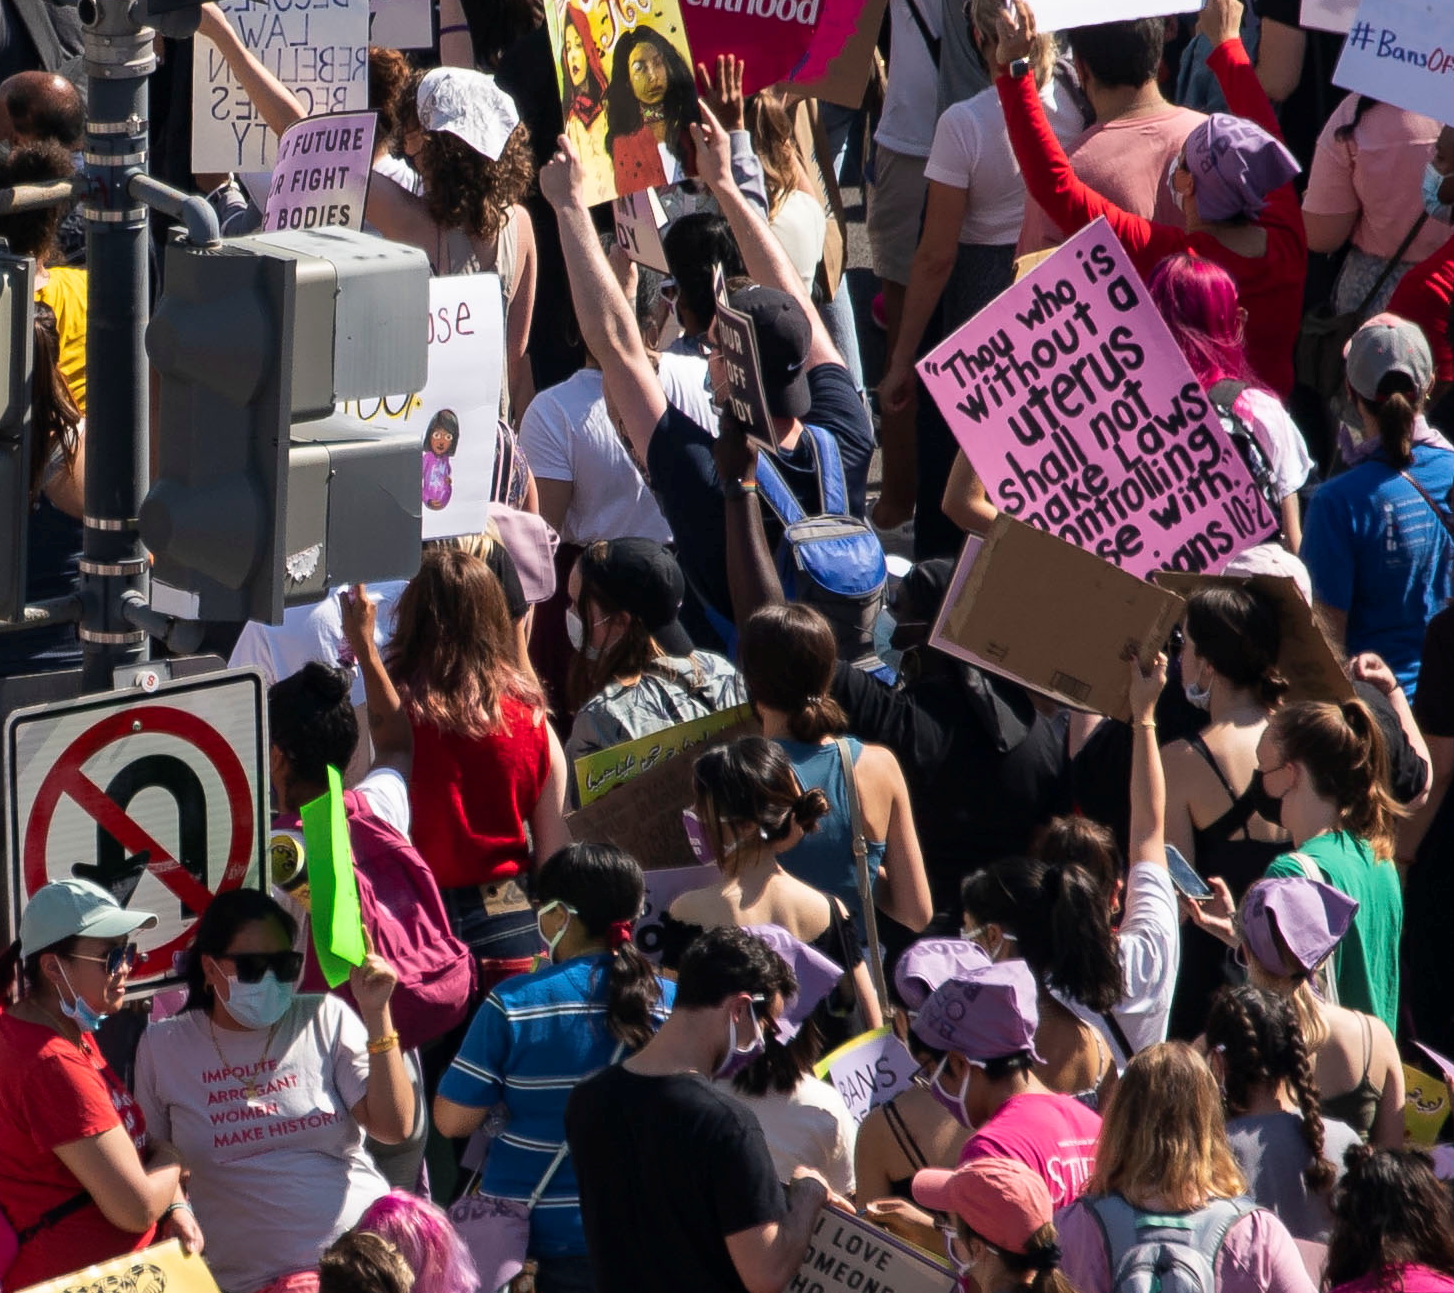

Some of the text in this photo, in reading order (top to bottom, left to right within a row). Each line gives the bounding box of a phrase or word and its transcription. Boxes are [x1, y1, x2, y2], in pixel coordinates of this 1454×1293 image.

[202, 1059, 277, 1083] IMPOLITE
[210, 1103, 278, 1125] WOMEN
[214, 1112, 342, 1148] MAKE HISTORY.
